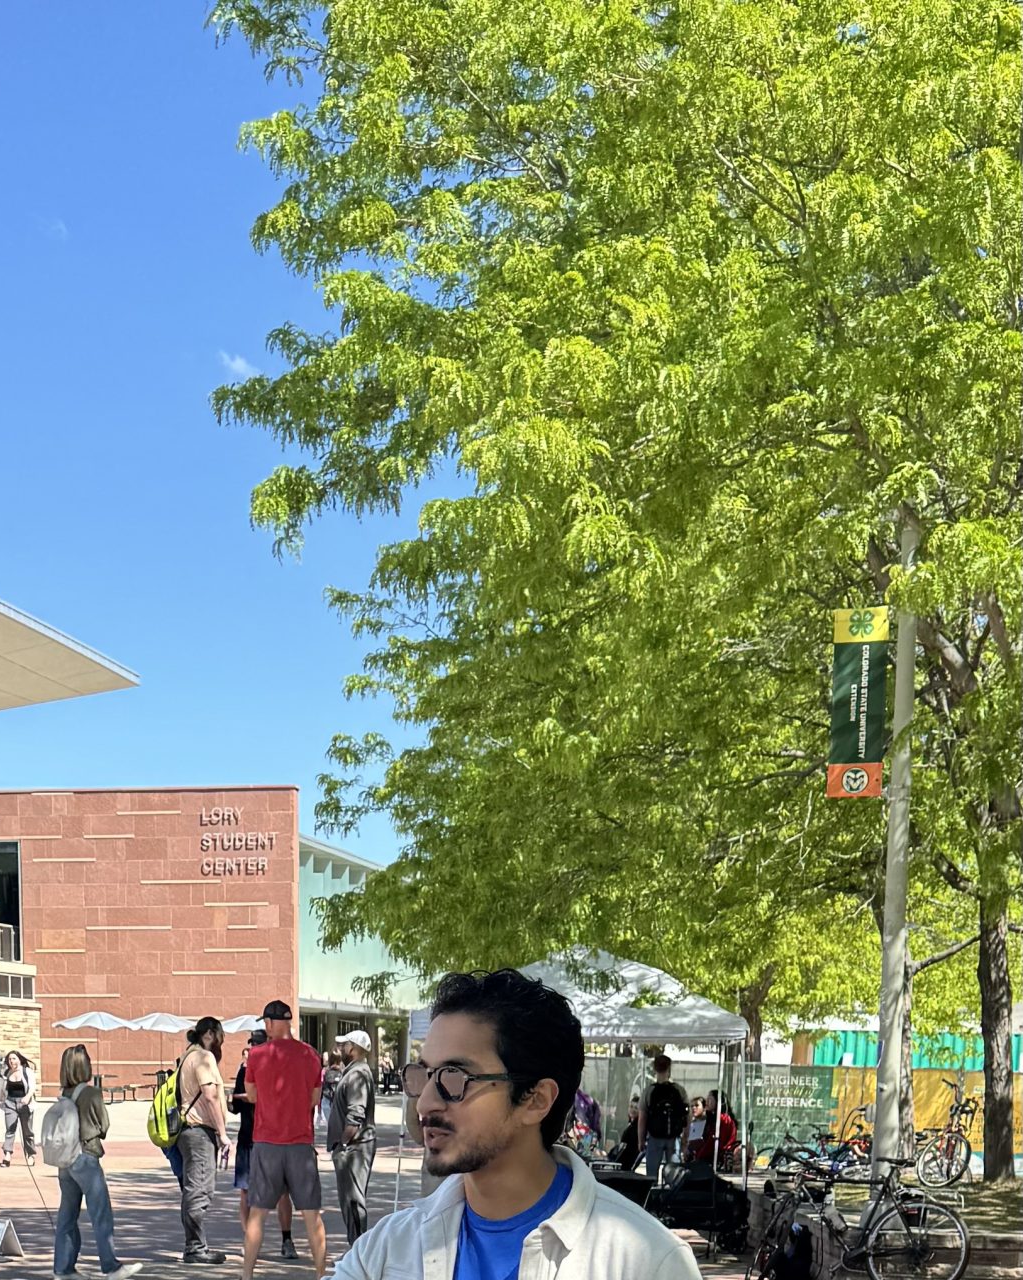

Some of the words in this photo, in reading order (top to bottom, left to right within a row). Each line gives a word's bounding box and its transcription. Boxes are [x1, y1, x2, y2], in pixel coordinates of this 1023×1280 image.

[860, 644, 870, 687] COLORADO
[859, 688, 868, 712] STATE
[858, 713, 867, 759] UNIVERSITY
[201, 807, 244, 824] LORY
[201, 832, 278, 849] STUDENT
[202, 857, 268, 874] CENTER
[763, 1075, 819, 1087] ENGINEER
[756, 1096, 824, 1108] DIFFERENCE
